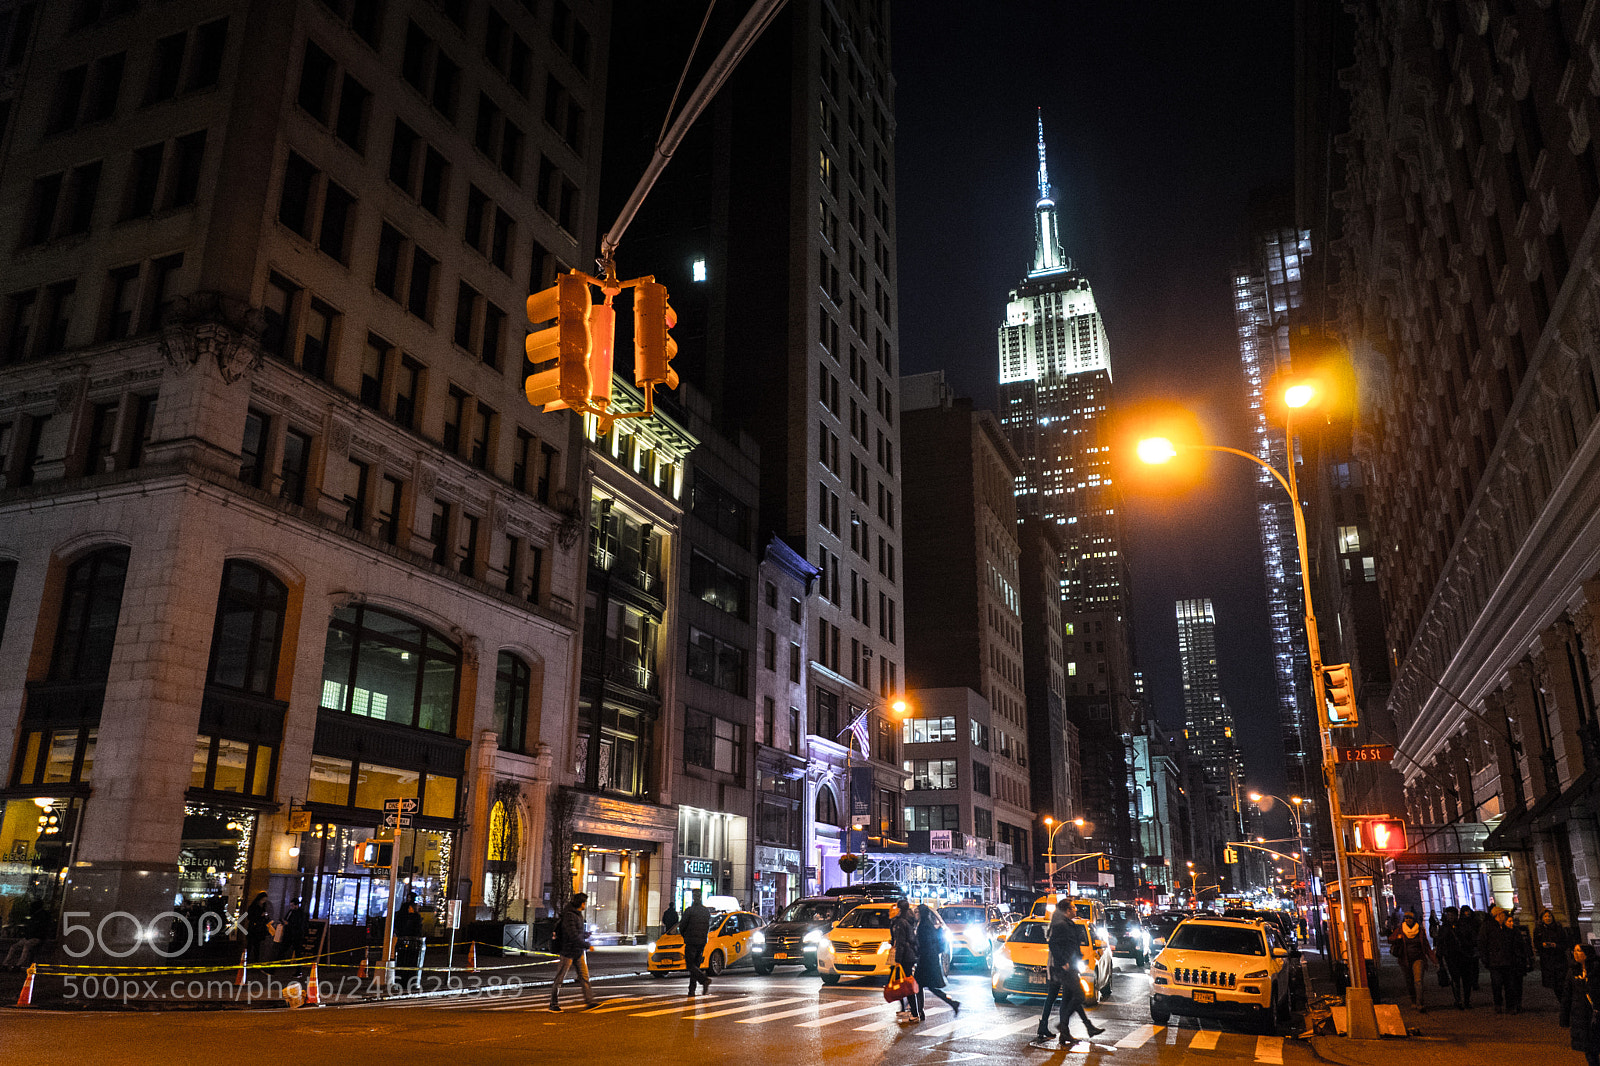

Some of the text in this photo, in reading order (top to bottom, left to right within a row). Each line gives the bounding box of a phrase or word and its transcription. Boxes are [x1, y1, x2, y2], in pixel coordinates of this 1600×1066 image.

[1346, 748, 1381, 761] E 26 St
[184, 857, 225, 867] BELGIAN
